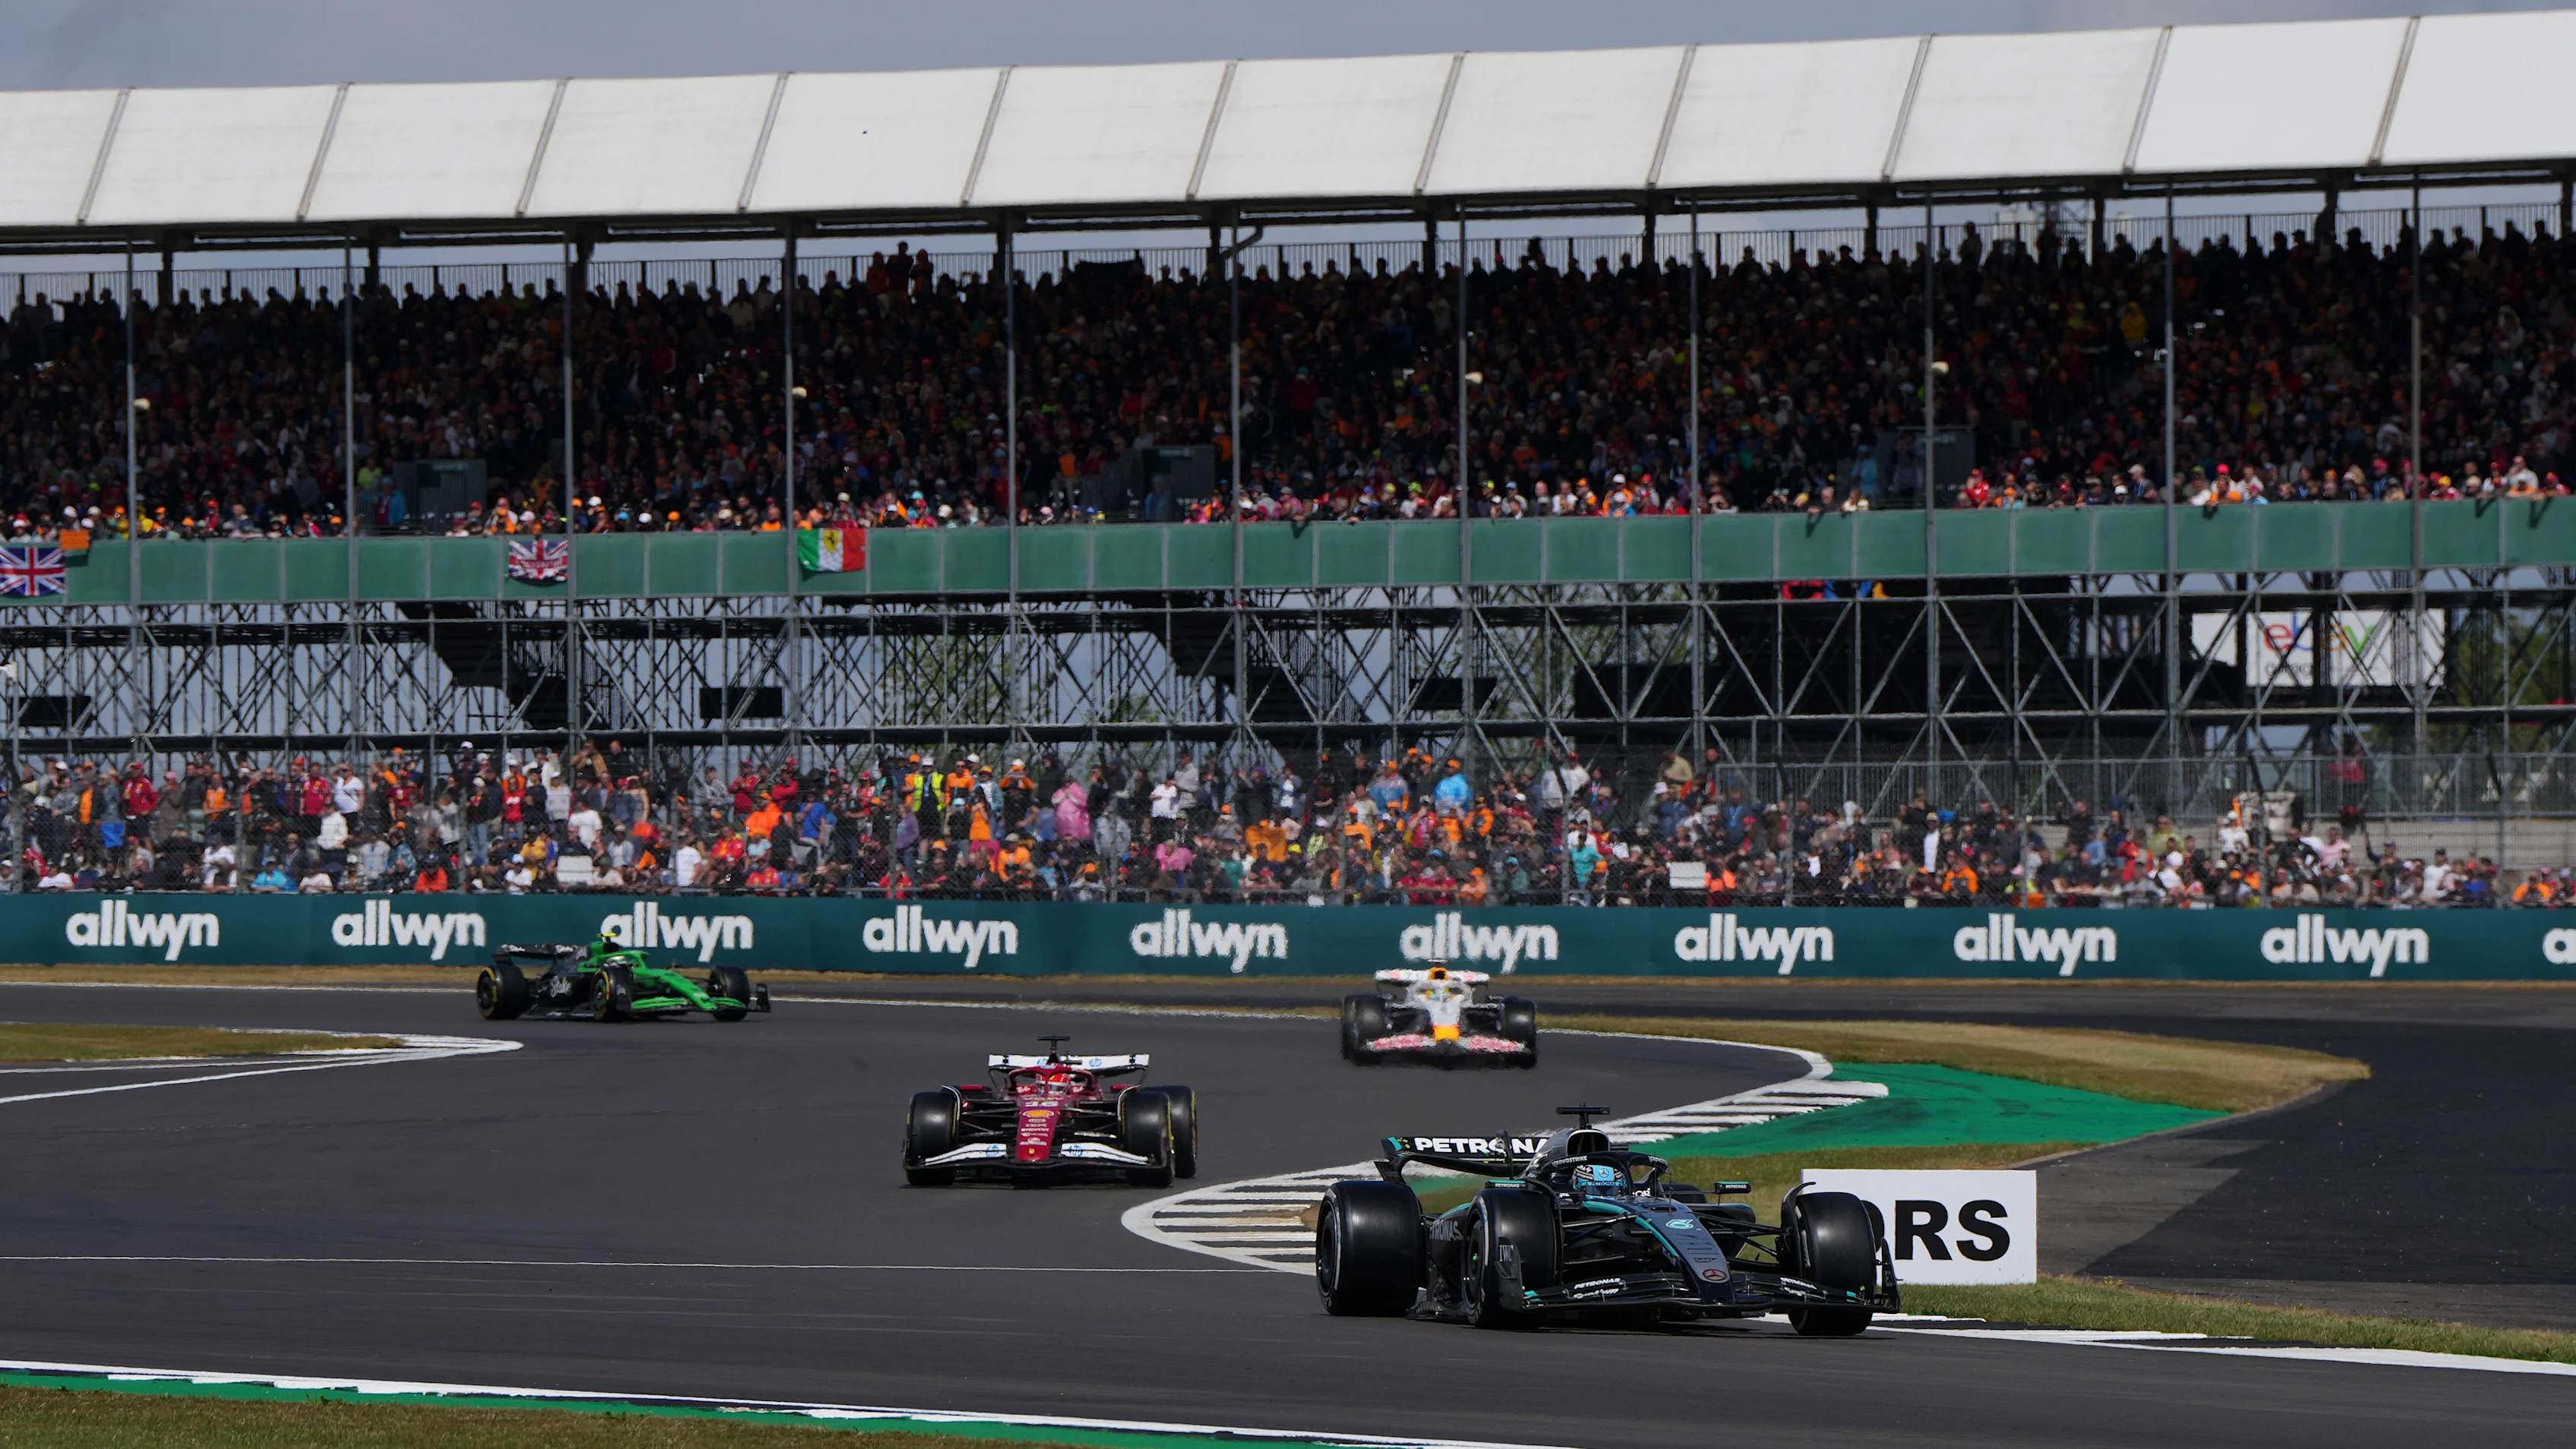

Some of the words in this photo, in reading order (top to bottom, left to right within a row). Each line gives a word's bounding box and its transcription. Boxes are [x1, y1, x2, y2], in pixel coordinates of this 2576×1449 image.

[66, 900, 219, 961] allwyn
[332, 900, 485, 961] allwyn
[601, 901, 753, 962] allwyn
[863, 905, 1018, 968] allwyn
[1131, 909, 1288, 973] allwyn
[1400, 912, 1558, 974] allwyn
[1675, 914, 1833, 975] allwyn
[1954, 914, 2117, 977] allwyn
[2262, 914, 2429, 977] allwyn
[550, 975, 573, 998] Stake
[1499, 1244, 1514, 1262] IWC
